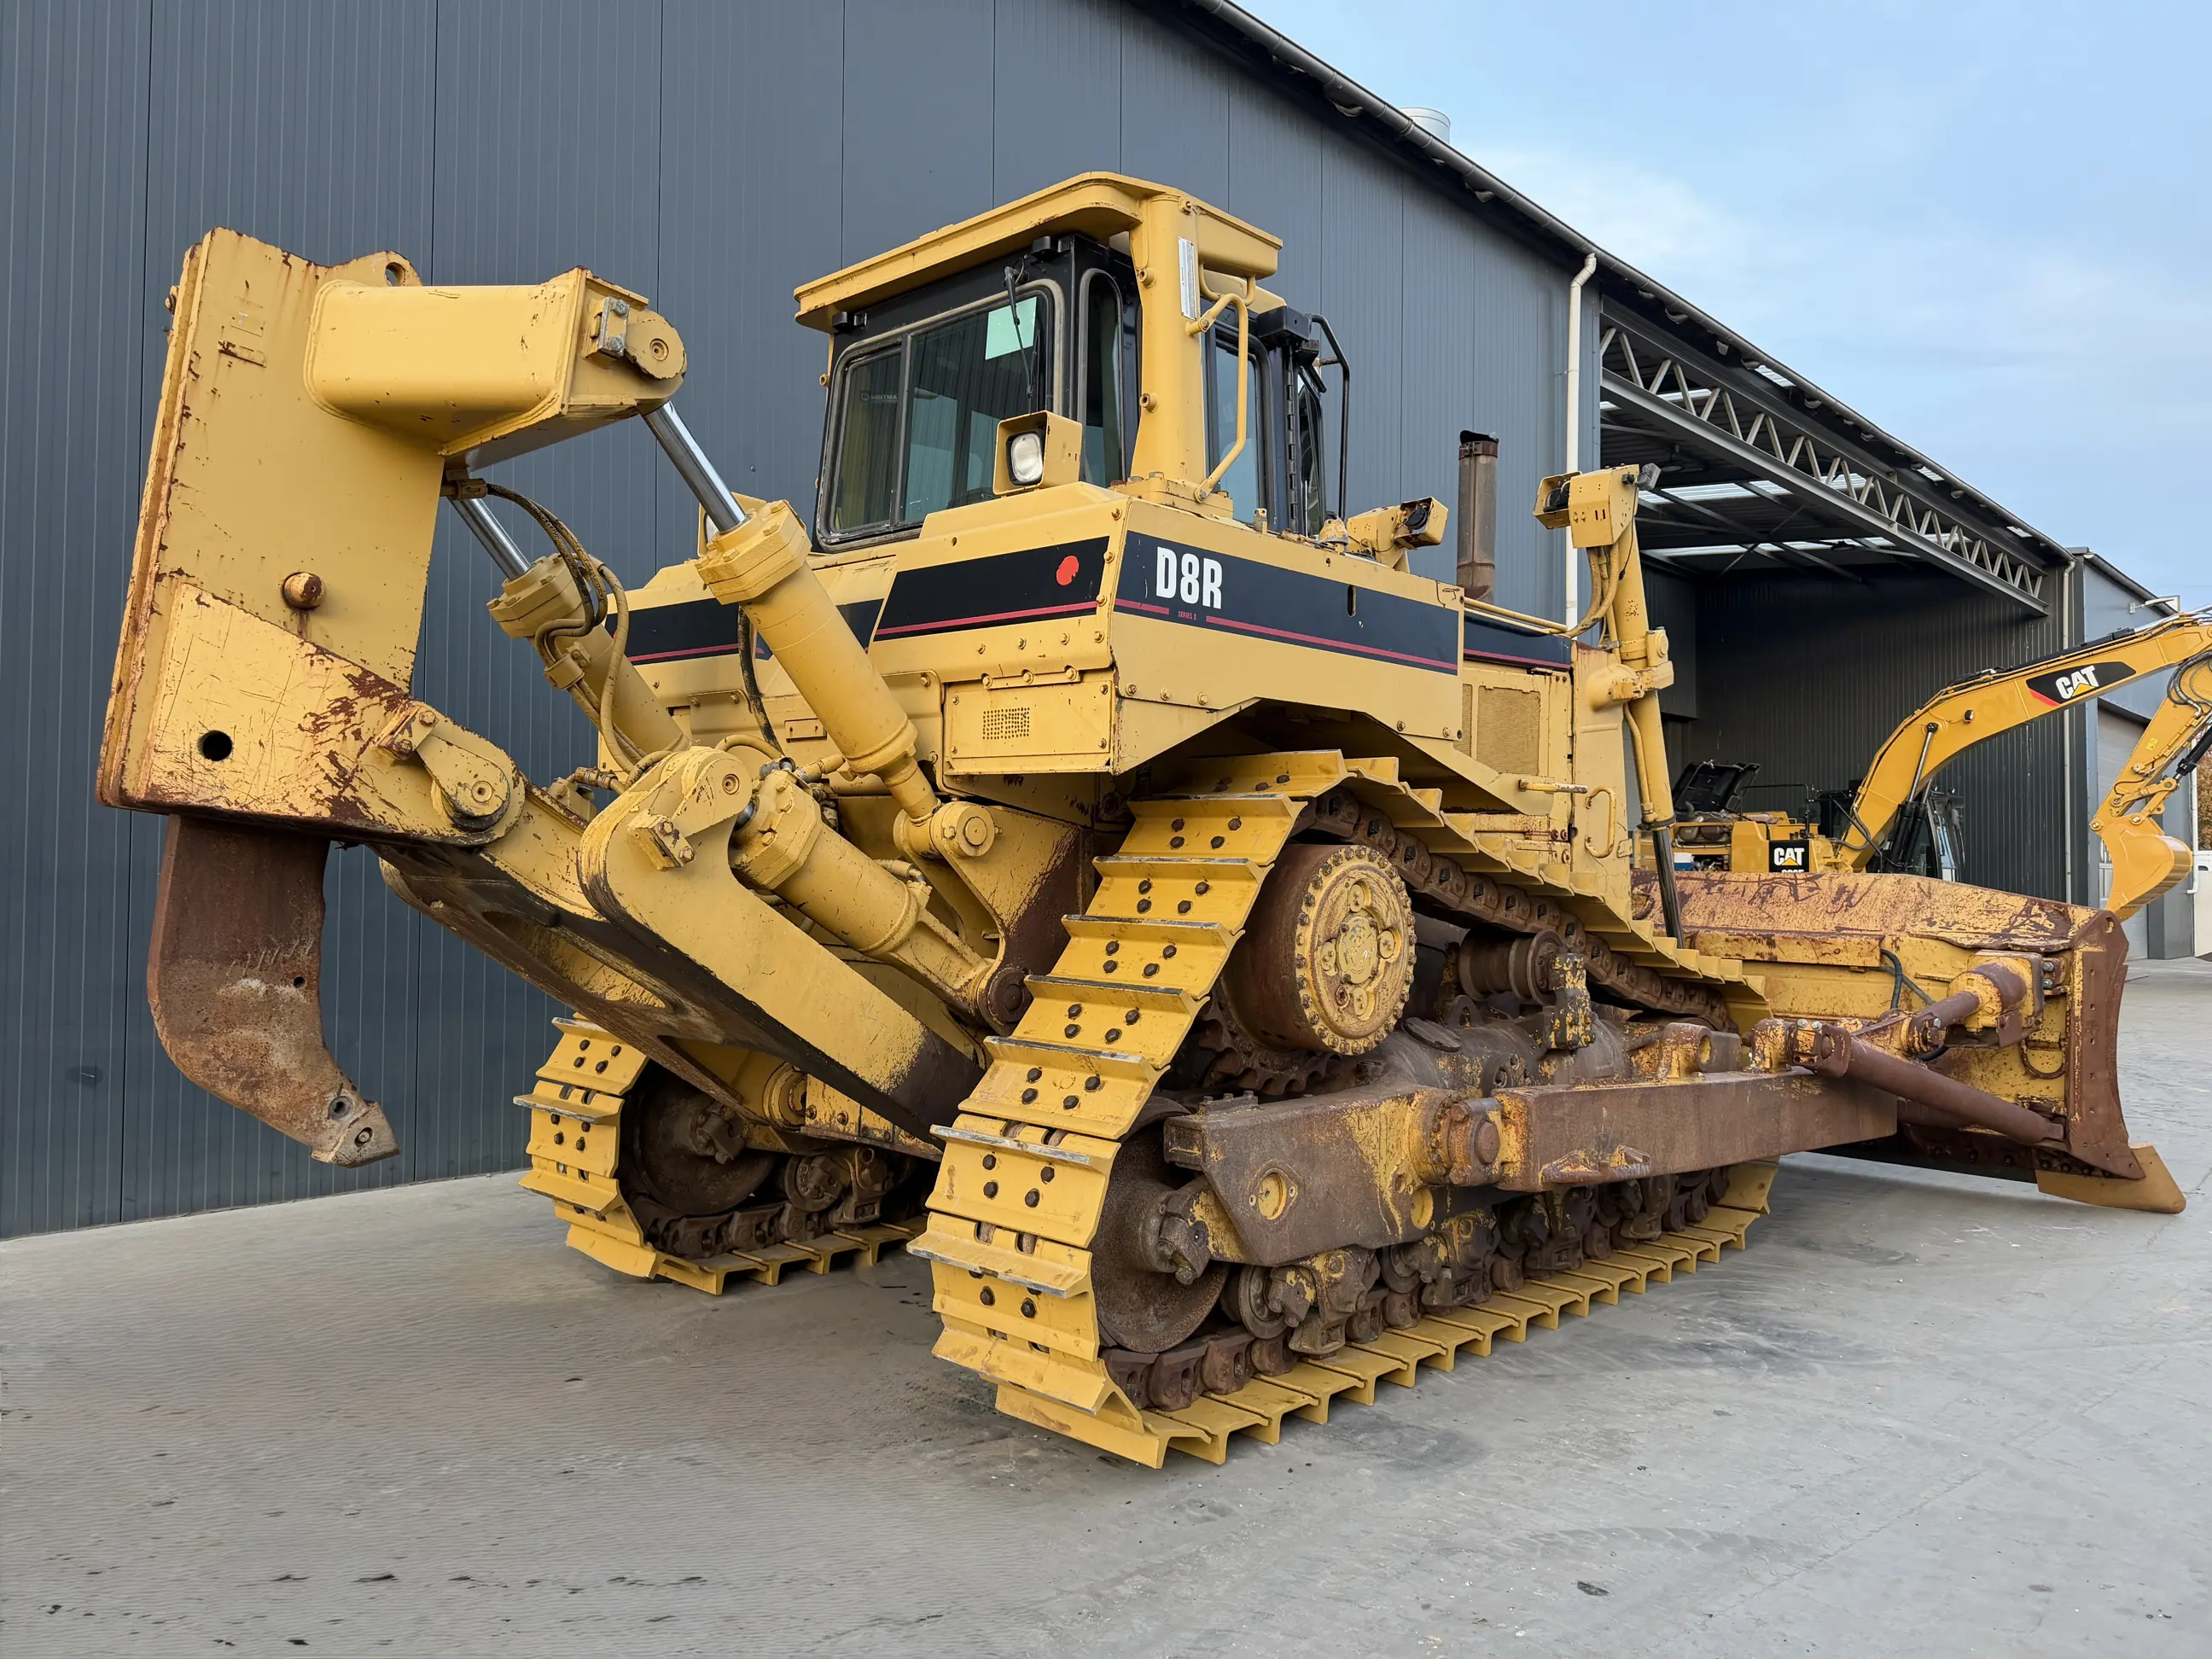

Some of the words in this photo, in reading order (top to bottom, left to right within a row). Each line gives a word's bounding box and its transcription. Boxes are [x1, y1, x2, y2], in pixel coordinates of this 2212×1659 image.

[1156, 546, 1222, 609] D8R
[1178, 610, 1193, 620] SERIES
[2055, 665, 2099, 700] CAT
[1773, 847, 1805, 866] CAT
